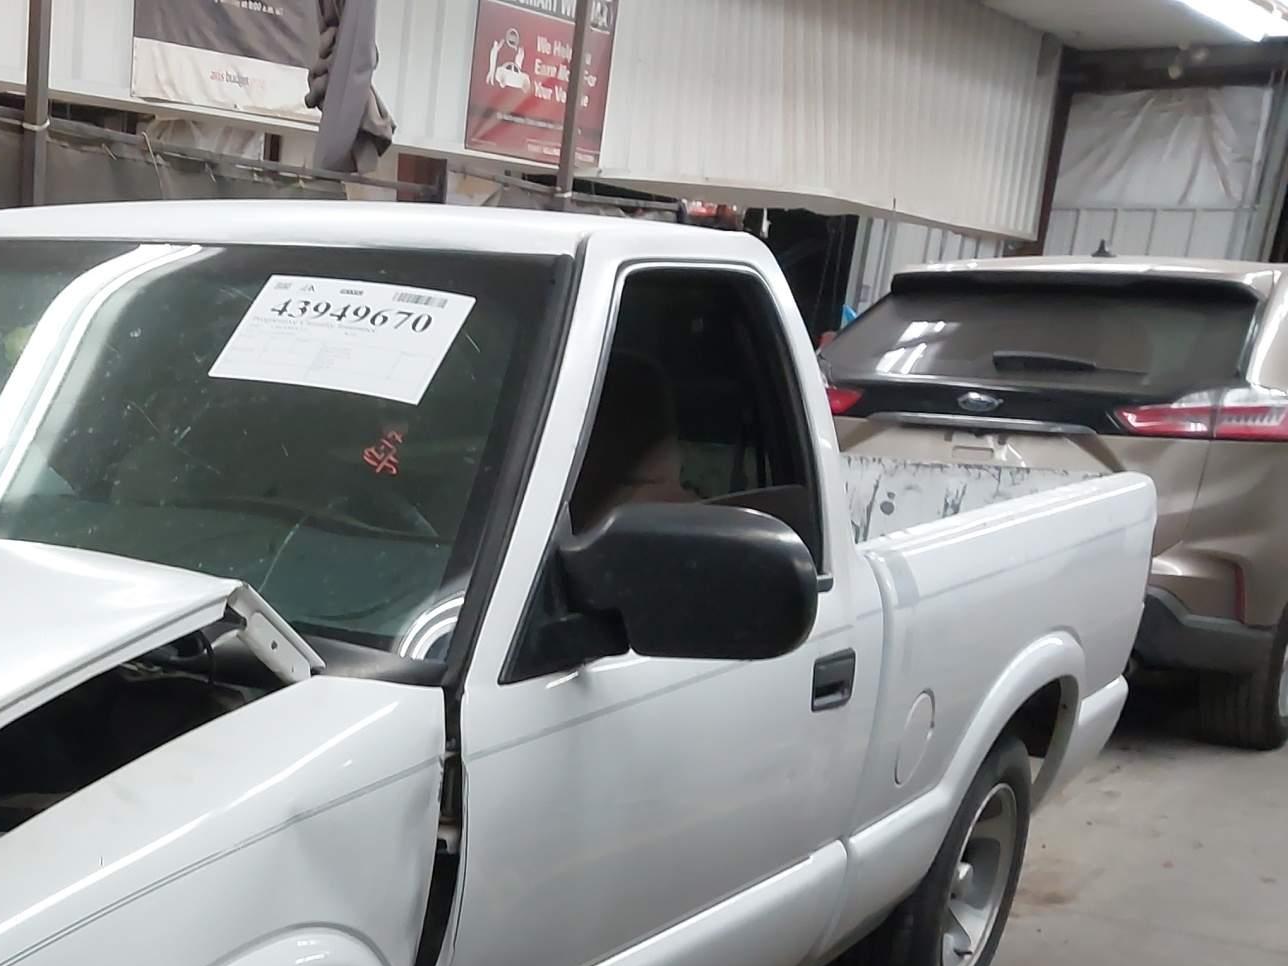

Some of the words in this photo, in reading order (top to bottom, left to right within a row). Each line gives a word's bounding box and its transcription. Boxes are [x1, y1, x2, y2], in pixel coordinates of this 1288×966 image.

[537, 35, 552, 55] We
[553, 39, 573, 63] Help
[534, 80, 553, 100] Your
[270, 298, 433, 333] 43949670
